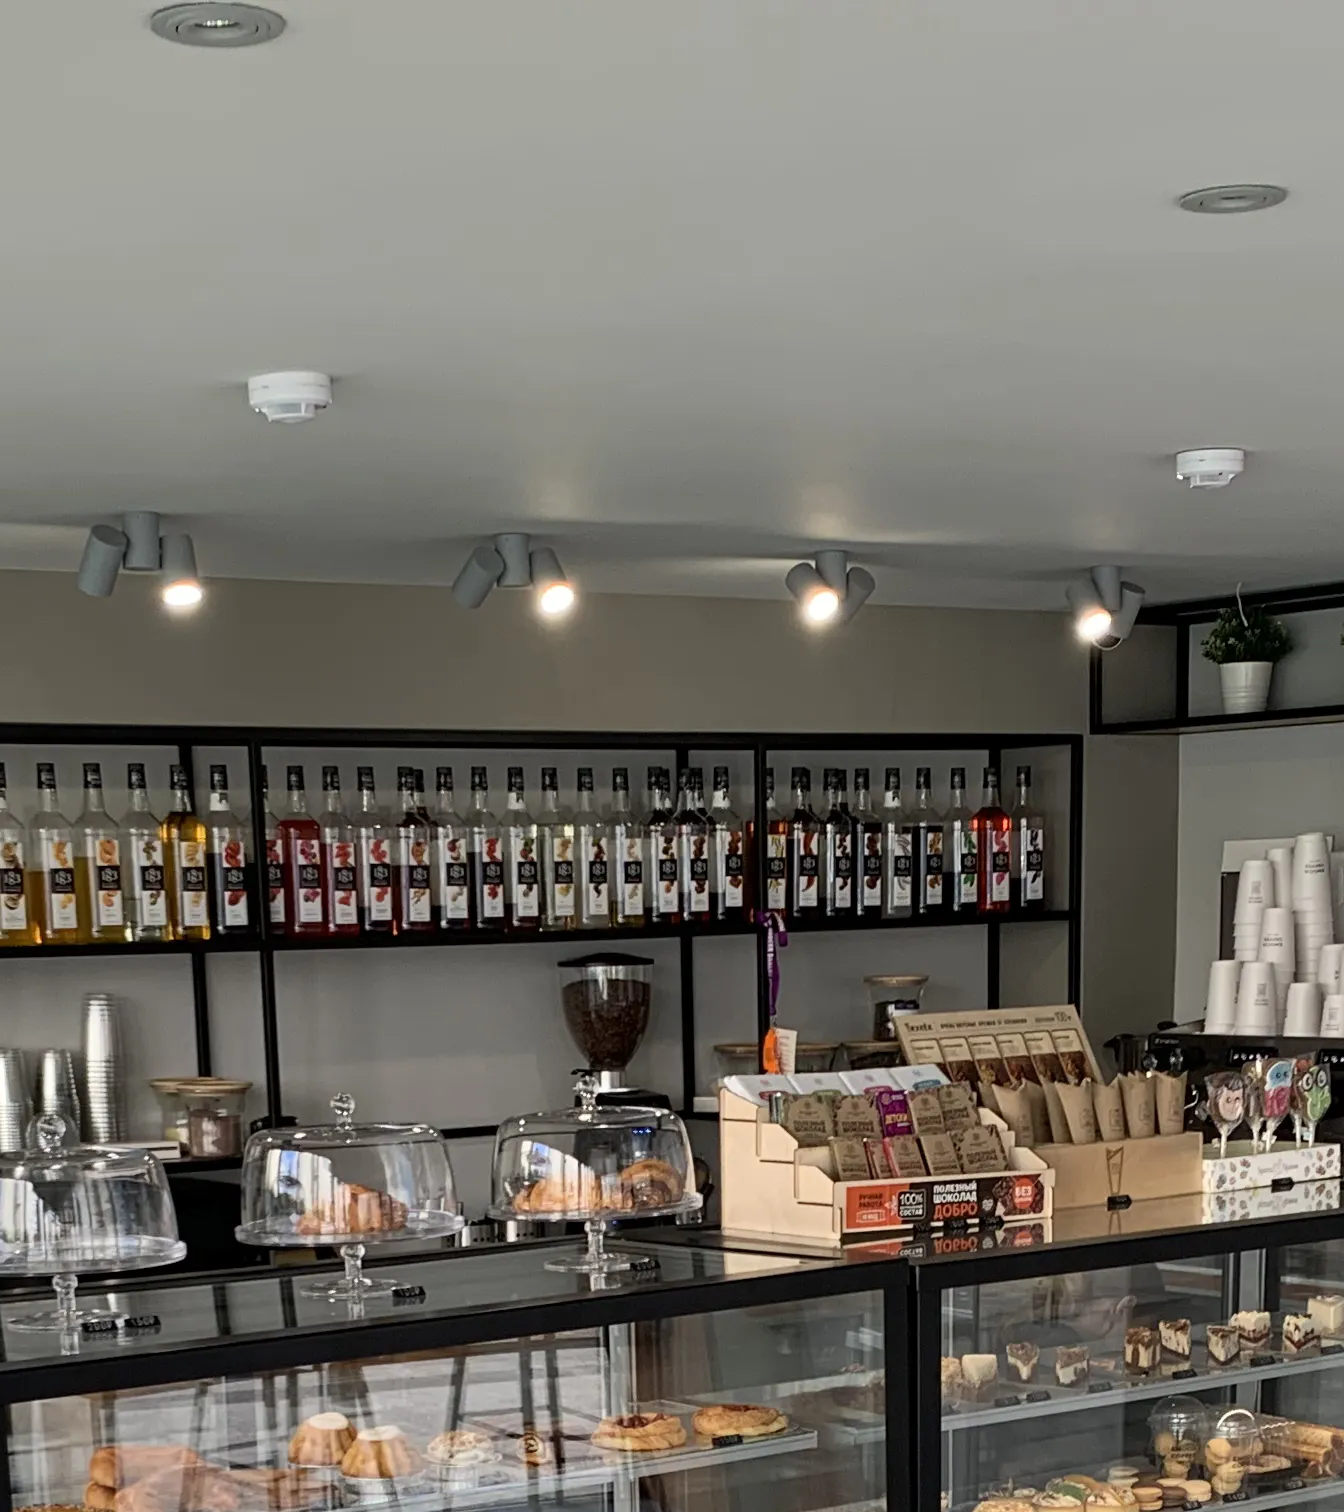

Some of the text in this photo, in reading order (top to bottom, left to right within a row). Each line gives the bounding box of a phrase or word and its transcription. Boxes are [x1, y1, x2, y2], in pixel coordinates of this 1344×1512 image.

[933, 1181, 978, 1193] ПОЛЕЗНЫЙ
[899, 1192, 923, 1205] 100%
[933, 1190, 978, 1203] ШОКОЛАД
[933, 1202, 978, 1219] ДОБРО
